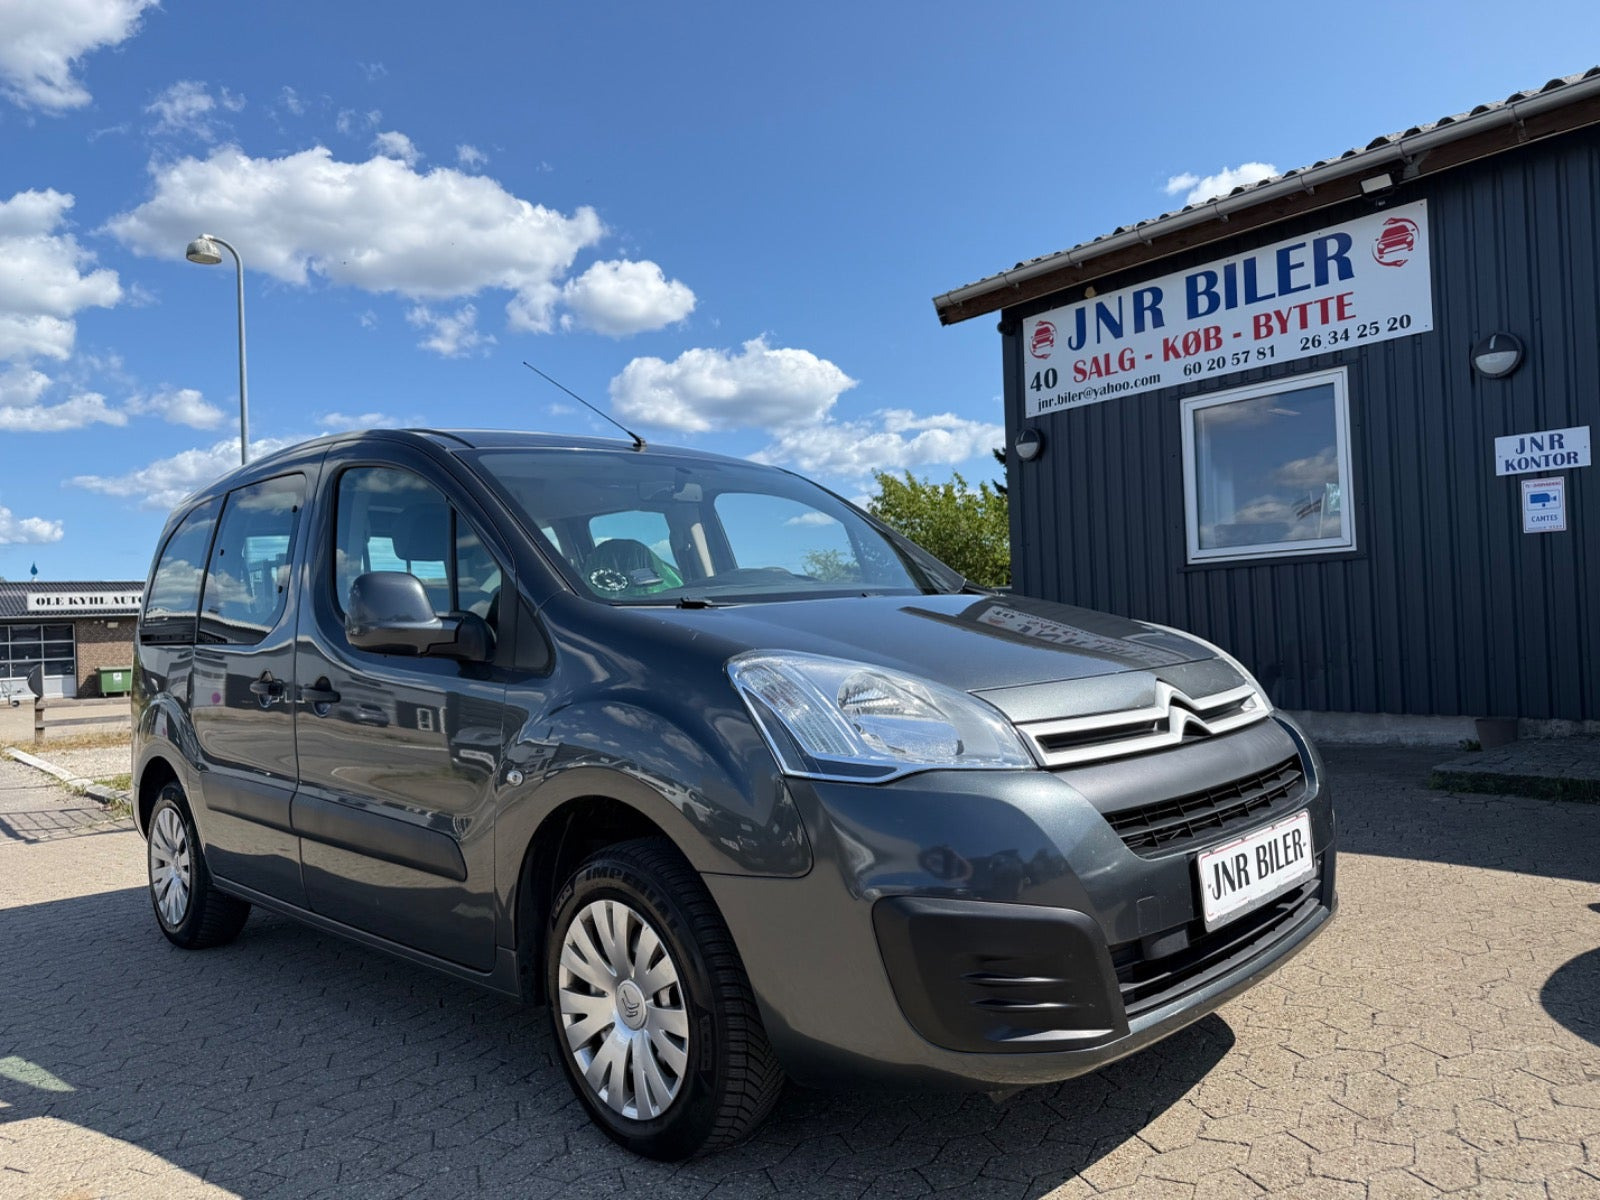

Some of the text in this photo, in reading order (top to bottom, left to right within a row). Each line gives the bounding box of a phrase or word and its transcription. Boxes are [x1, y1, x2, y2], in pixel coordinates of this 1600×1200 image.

[1068, 232, 1355, 351] JNR BILER
[1073, 347, 1136, 383] SALG
[1163, 325, 1223, 362] KØB
[1253, 292, 1357, 341] BYTTE
[1300, 314, 1411, 351] 26 34 25 20
[1183, 345, 1275, 376] 60 20 57 81
[1030, 367, 1058, 392] 40
[1038, 373, 1161, 412] jnr.biler@yahoo.com
[1515, 433, 1565, 455] JNR
[1505, 451, 1579, 472] KONTOR
[36, 596, 64, 606] OLE
[1212, 828, 1304, 901] JNR BILER
